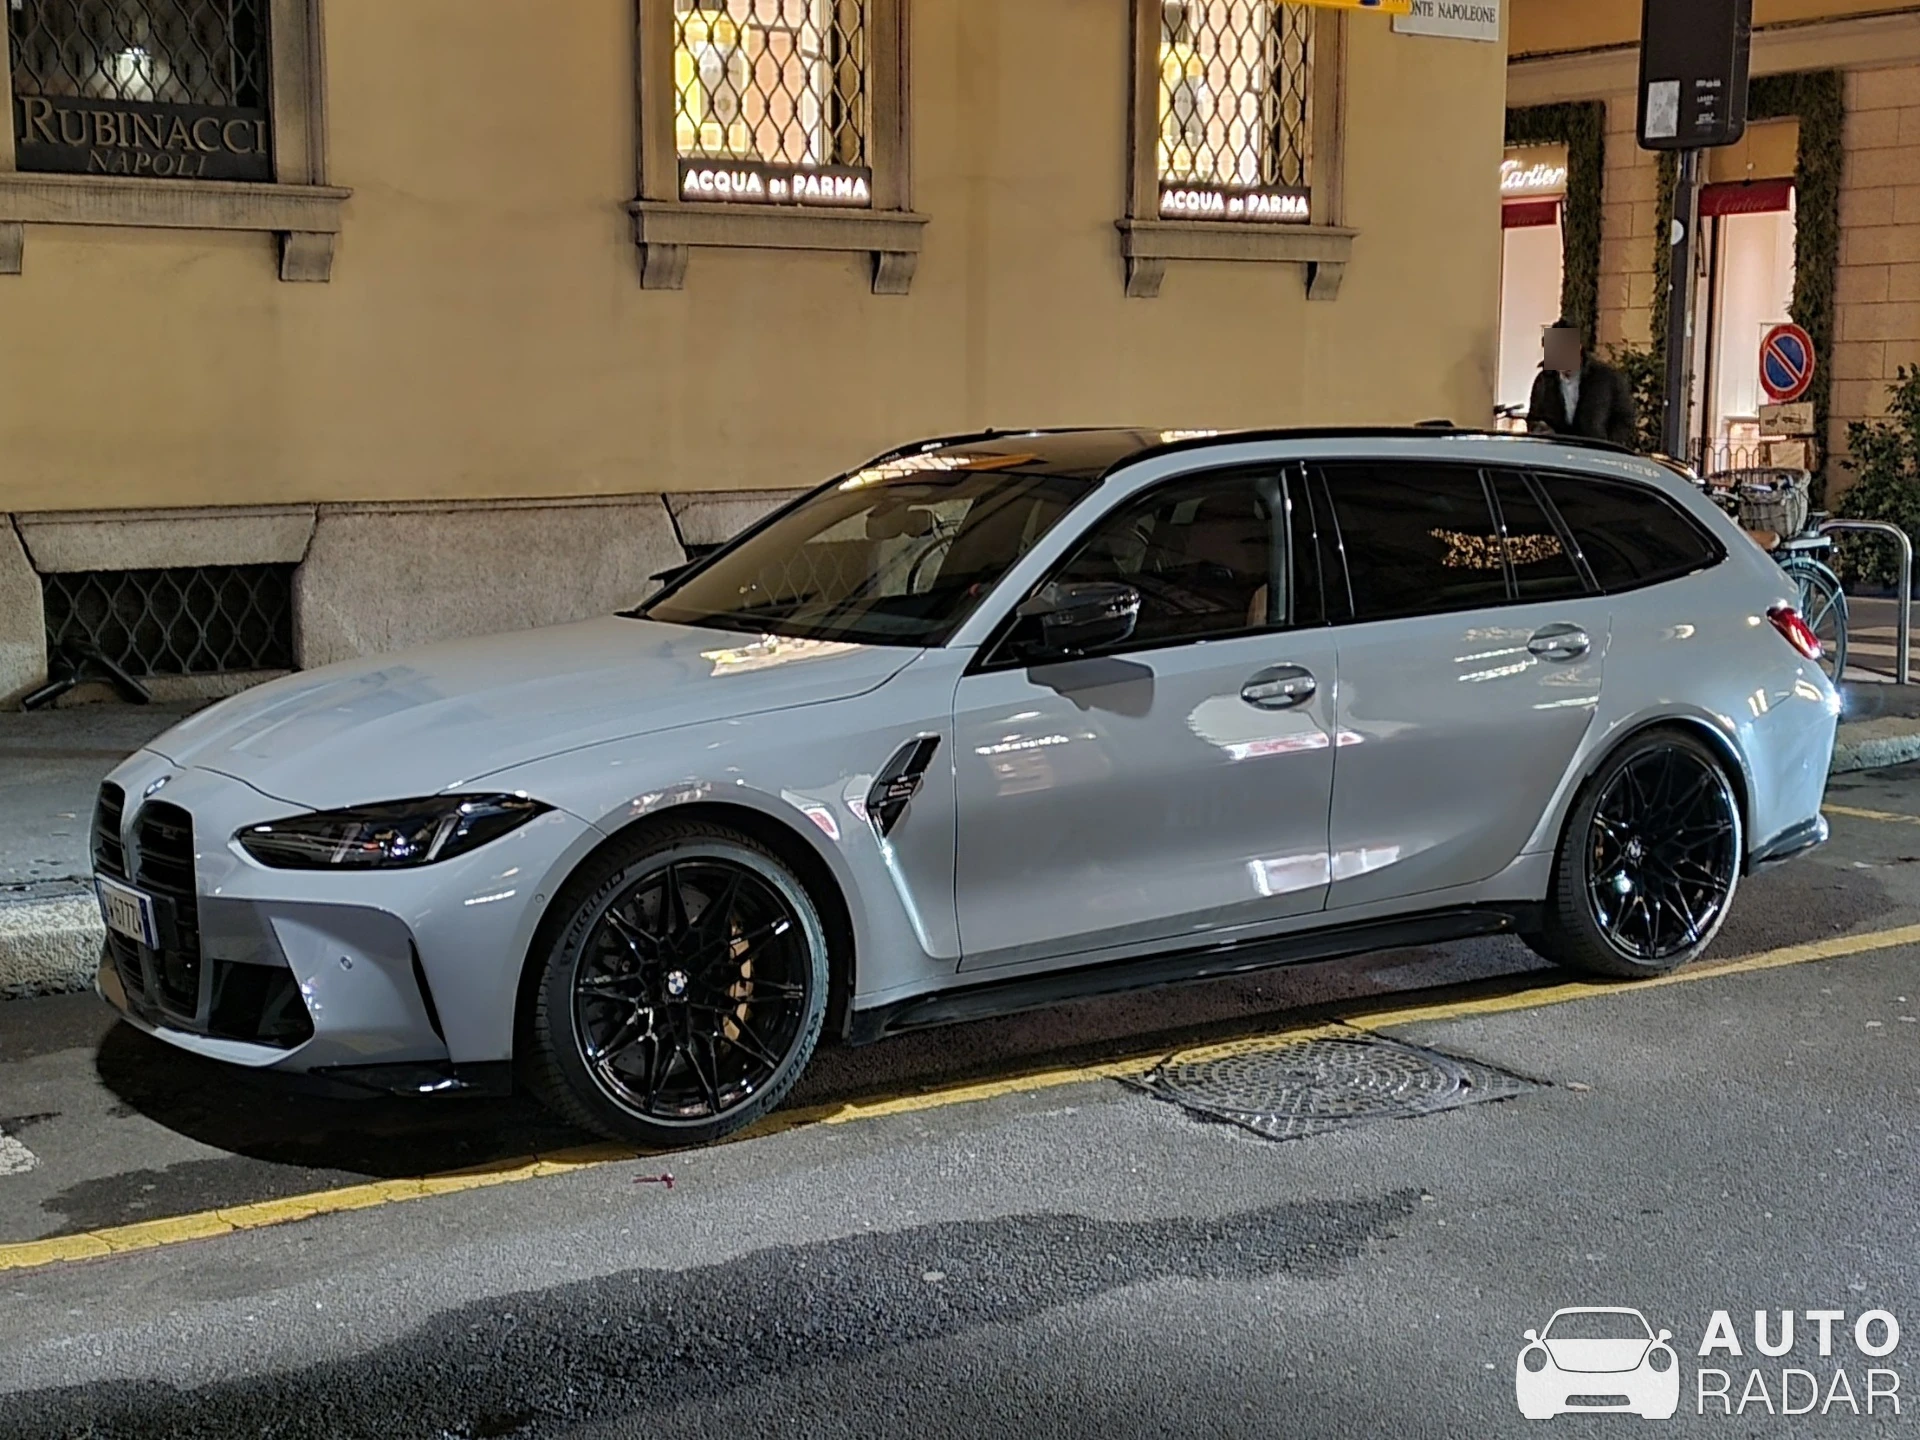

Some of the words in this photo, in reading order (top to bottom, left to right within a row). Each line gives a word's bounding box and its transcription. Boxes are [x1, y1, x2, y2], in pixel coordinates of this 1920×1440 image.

[1438, 2, 1496, 24] NAPOLEONE
[18, 96, 267, 155] RUBINACCI
[86, 149, 208, 177] NAPOLI
[1500, 160, 1565, 189] Cartier
[683, 169, 762, 193] ACQUA
[793, 174, 868, 198] PARMA
[1162, 189, 1225, 210] ACQUA
[1247, 194, 1309, 213] PARMA
[565, 871, 621, 947] MICHELIN
